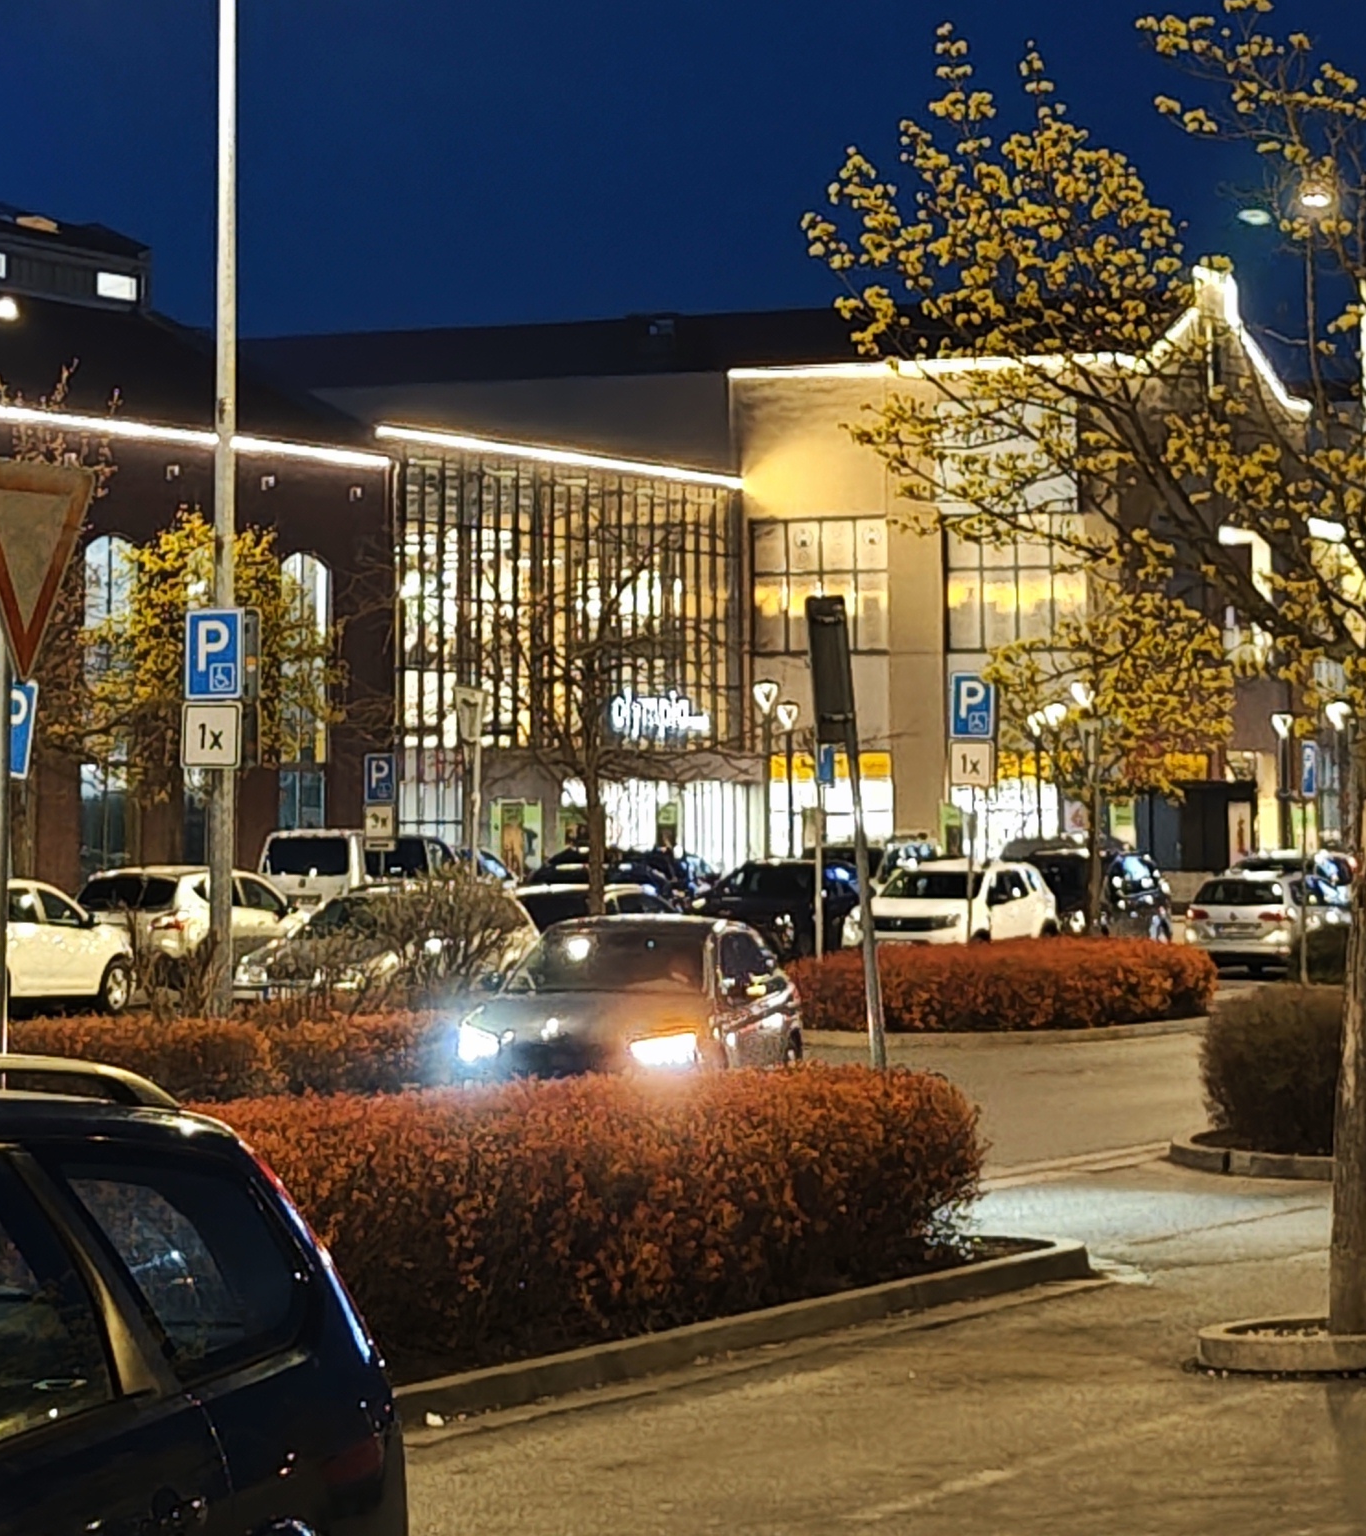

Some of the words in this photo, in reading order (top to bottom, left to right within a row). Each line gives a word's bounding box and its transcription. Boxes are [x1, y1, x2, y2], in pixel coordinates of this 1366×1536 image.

[197, 620, 230, 673] P
[958, 680, 986, 720] P
[197, 722, 224, 751] 1x
[370, 759, 390, 790] P
[960, 753, 981, 776] 1x
